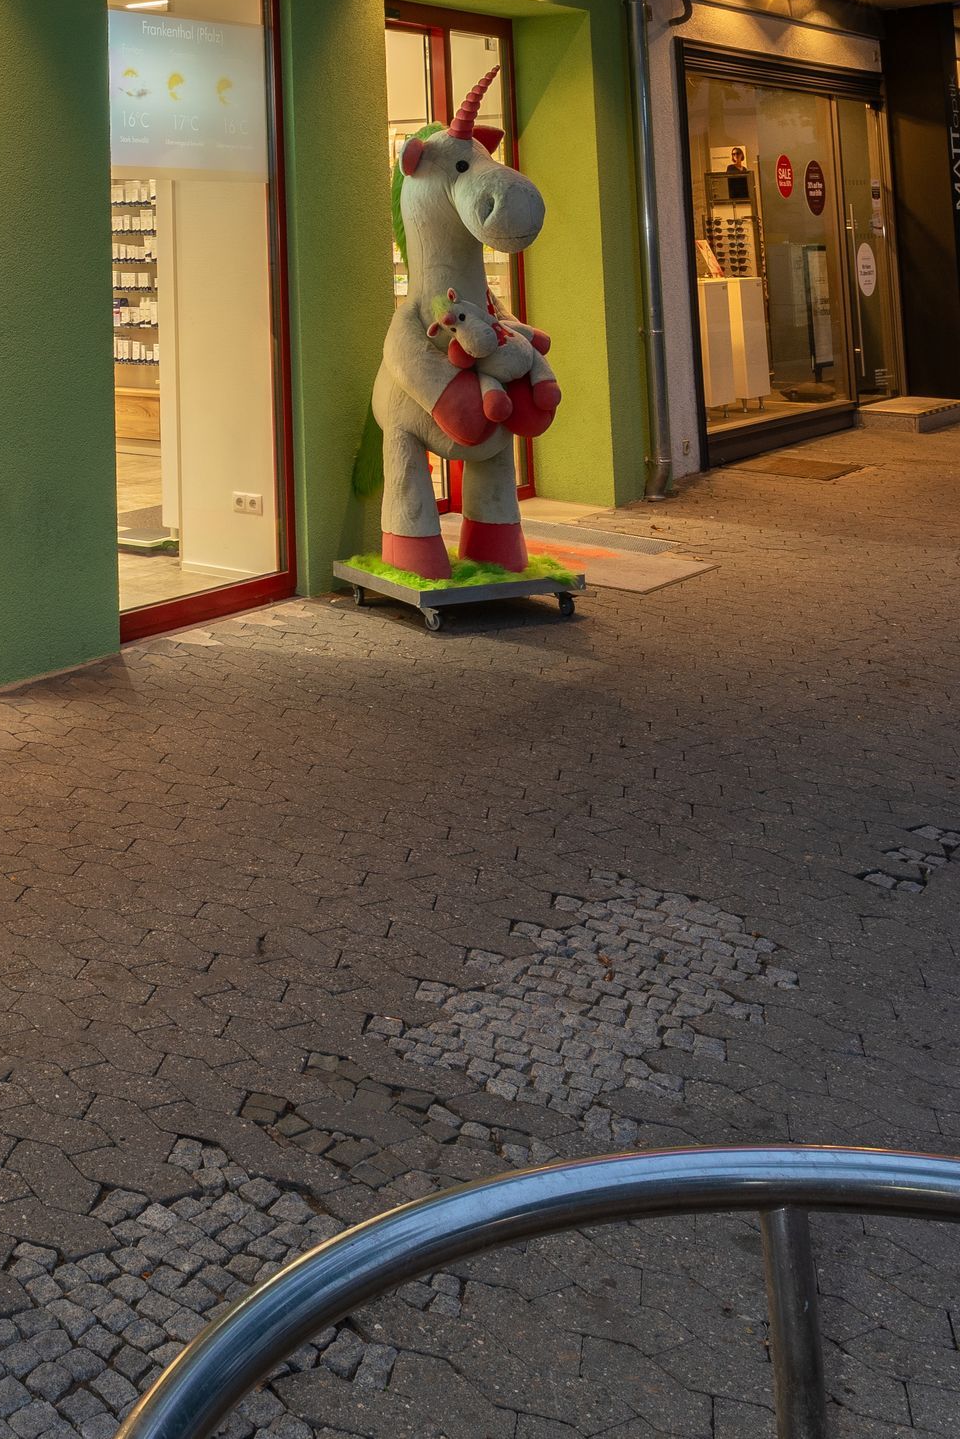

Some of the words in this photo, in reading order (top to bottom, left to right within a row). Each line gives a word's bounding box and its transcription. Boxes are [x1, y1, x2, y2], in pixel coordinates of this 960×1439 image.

[142, 20, 194, 42] Frankenthal
[196, 26, 225, 45] (Pfalz)
[778, 168, 792, 180] SALE
